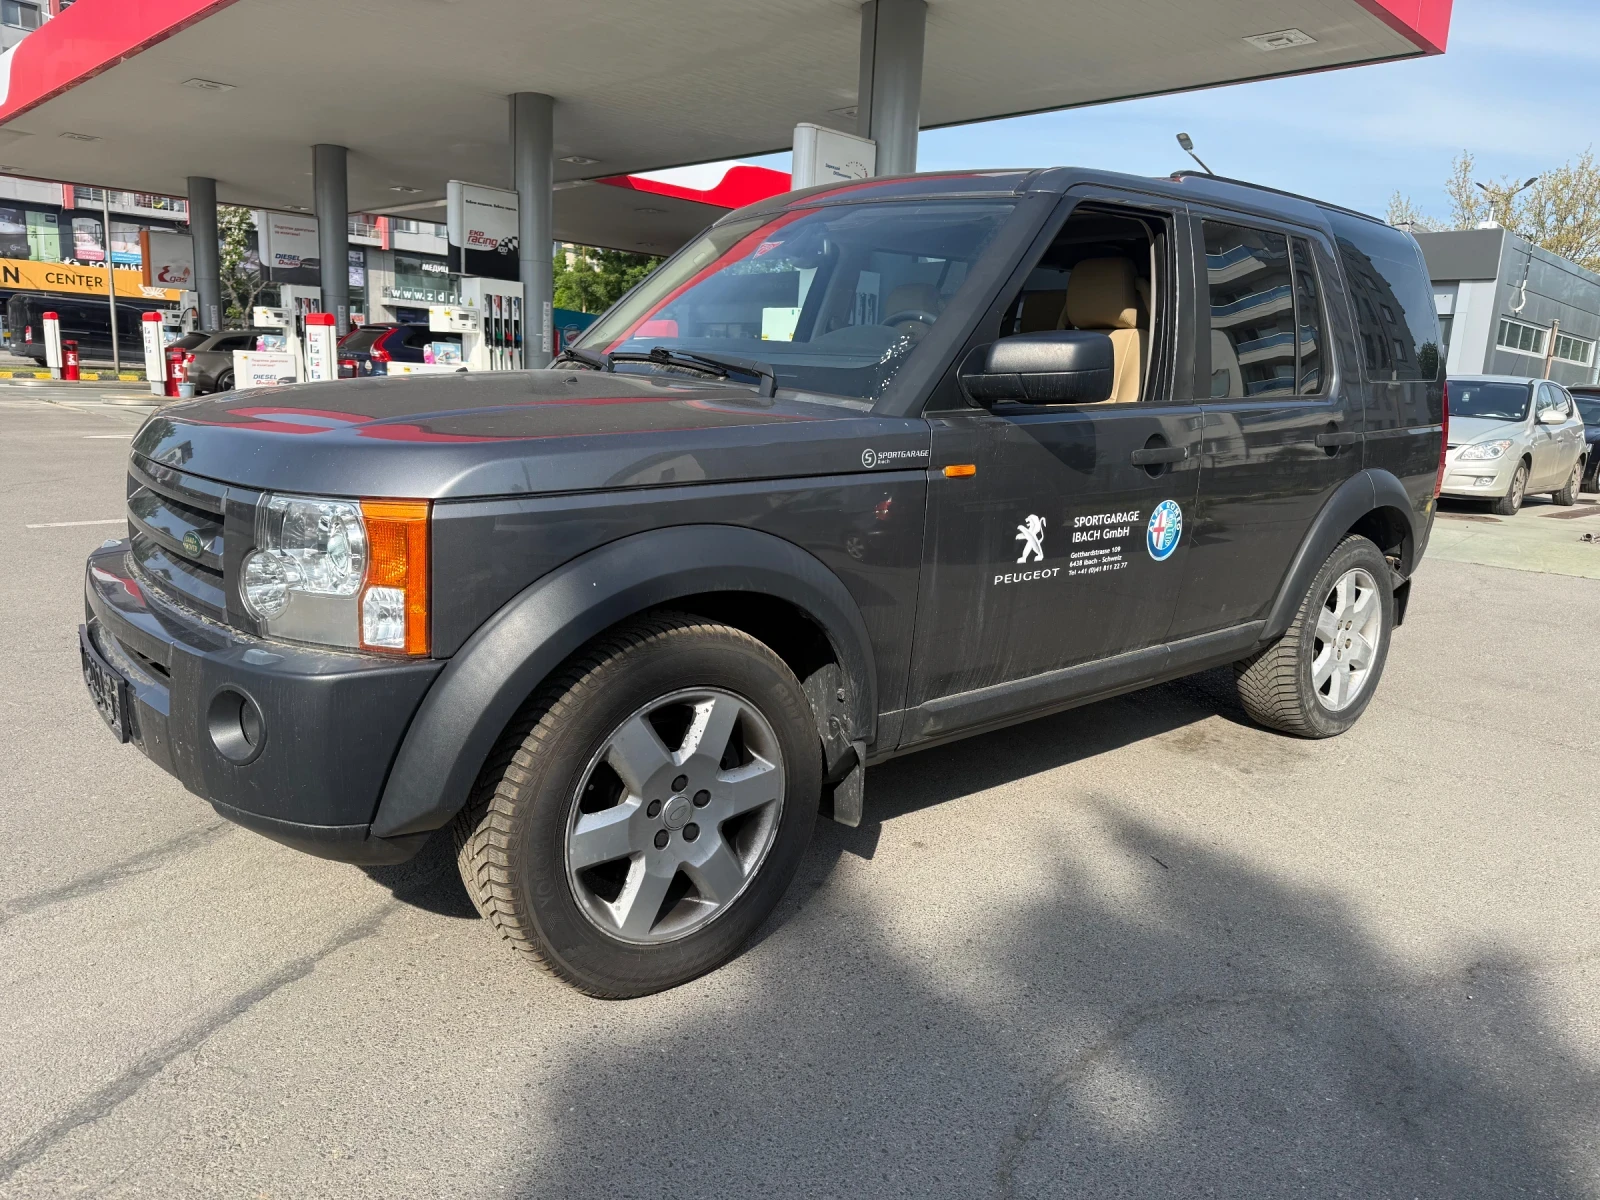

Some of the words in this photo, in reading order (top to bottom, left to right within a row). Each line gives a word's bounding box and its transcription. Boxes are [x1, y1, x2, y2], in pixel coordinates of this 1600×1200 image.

[469, 229, 484, 237] EKO
[467, 235, 498, 249] racing
[275, 253, 301, 261] DIESEL
[278, 259, 300, 267] Double
[45, 272, 103, 288] CENTER
[877, 449, 930, 461] SPORTGARAGE
[1074, 510, 1140, 528] SPORTGARAGE
[1072, 529, 1101, 544] IBACH
[1102, 526, 1130, 540] GmbH
[1070, 548, 1111, 559] Gotthardstrasse
[1069, 559, 1083, 568] 6438
[1083, 558, 1098, 566] Ibach
[1102, 554, 1123, 563] Schweiz
[1088, 566, 1102, 574] (0)41
[1120, 561, 1128, 569] 77
[993, 567, 1061, 585] PEUGEOT
